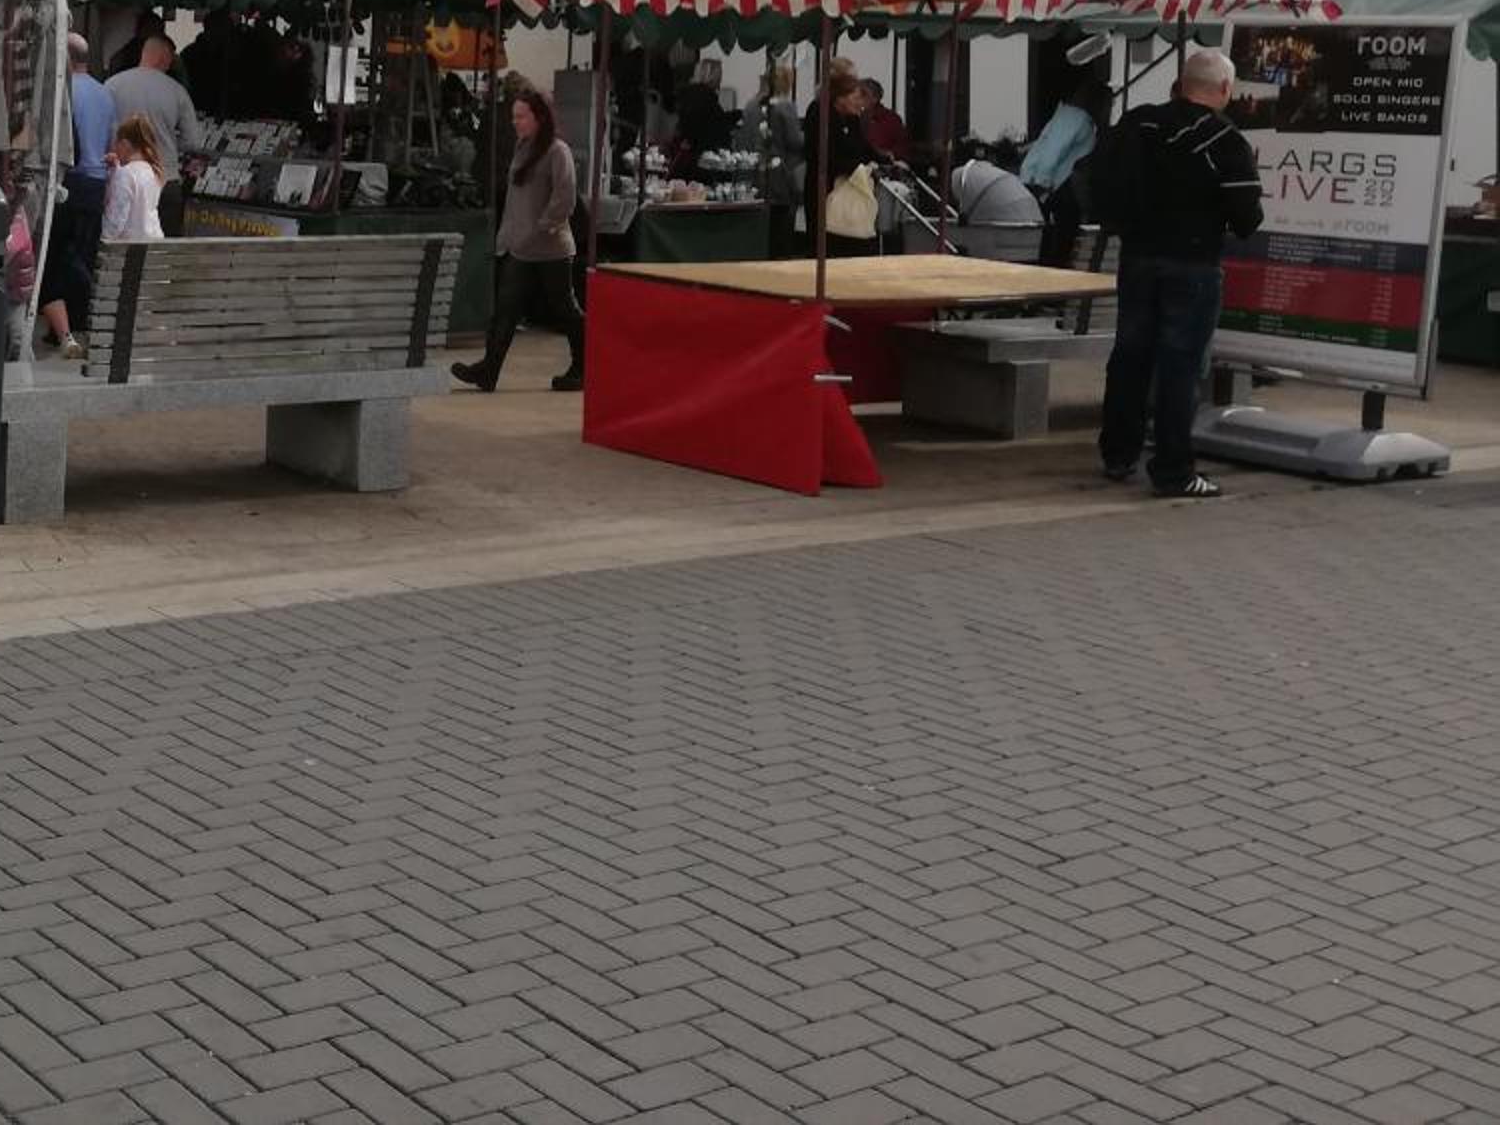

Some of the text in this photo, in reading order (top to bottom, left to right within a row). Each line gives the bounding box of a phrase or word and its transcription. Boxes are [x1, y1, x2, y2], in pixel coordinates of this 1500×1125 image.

[1353, 76, 1391, 87] OPEN
[1333, 94, 1441, 106] SOLO SINGERS
[1341, 111, 1429, 124] LIVE BANDS
[1253, 147, 1397, 178] LARGS
